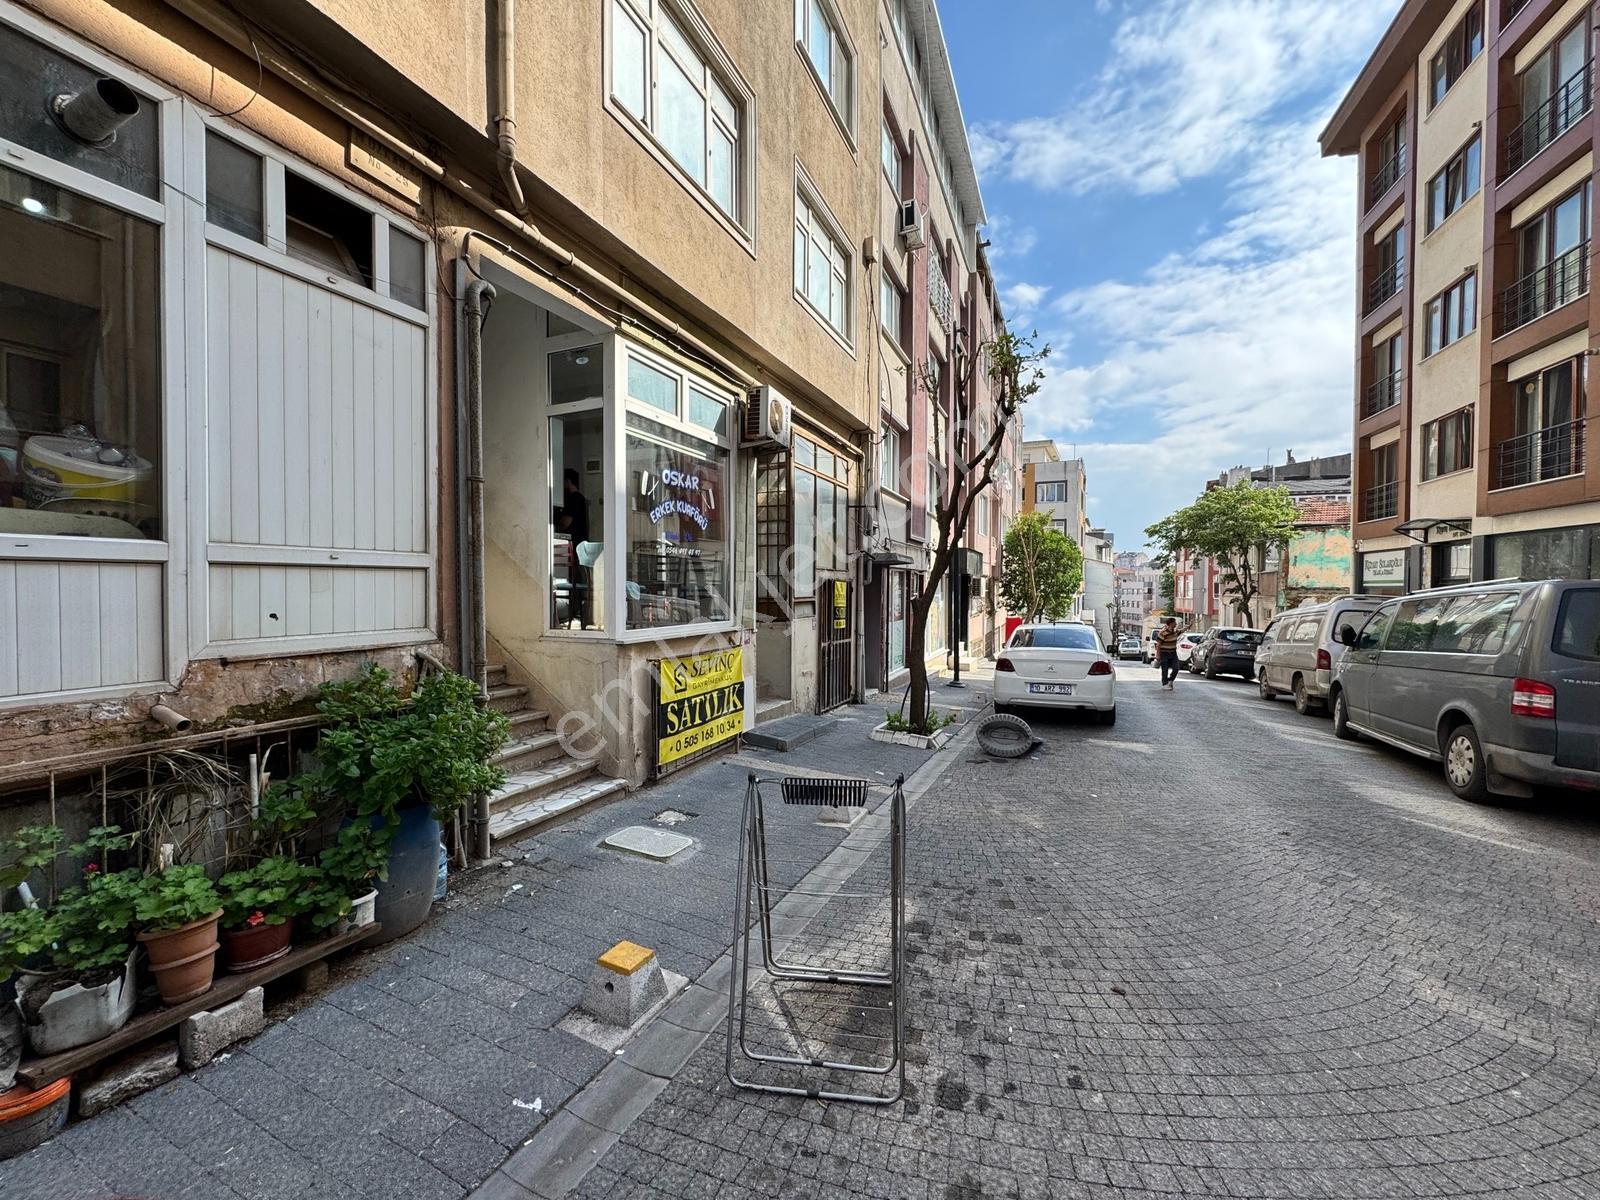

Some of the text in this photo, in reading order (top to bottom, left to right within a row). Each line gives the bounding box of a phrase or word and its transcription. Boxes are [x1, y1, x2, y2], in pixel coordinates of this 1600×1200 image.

[662, 469, 700, 490] OSKAR
[650, 500, 675, 524] ERKEK
[667, 684, 743, 735] SATILIK
[675, 719, 736, 752] 0 505 168 10 34
